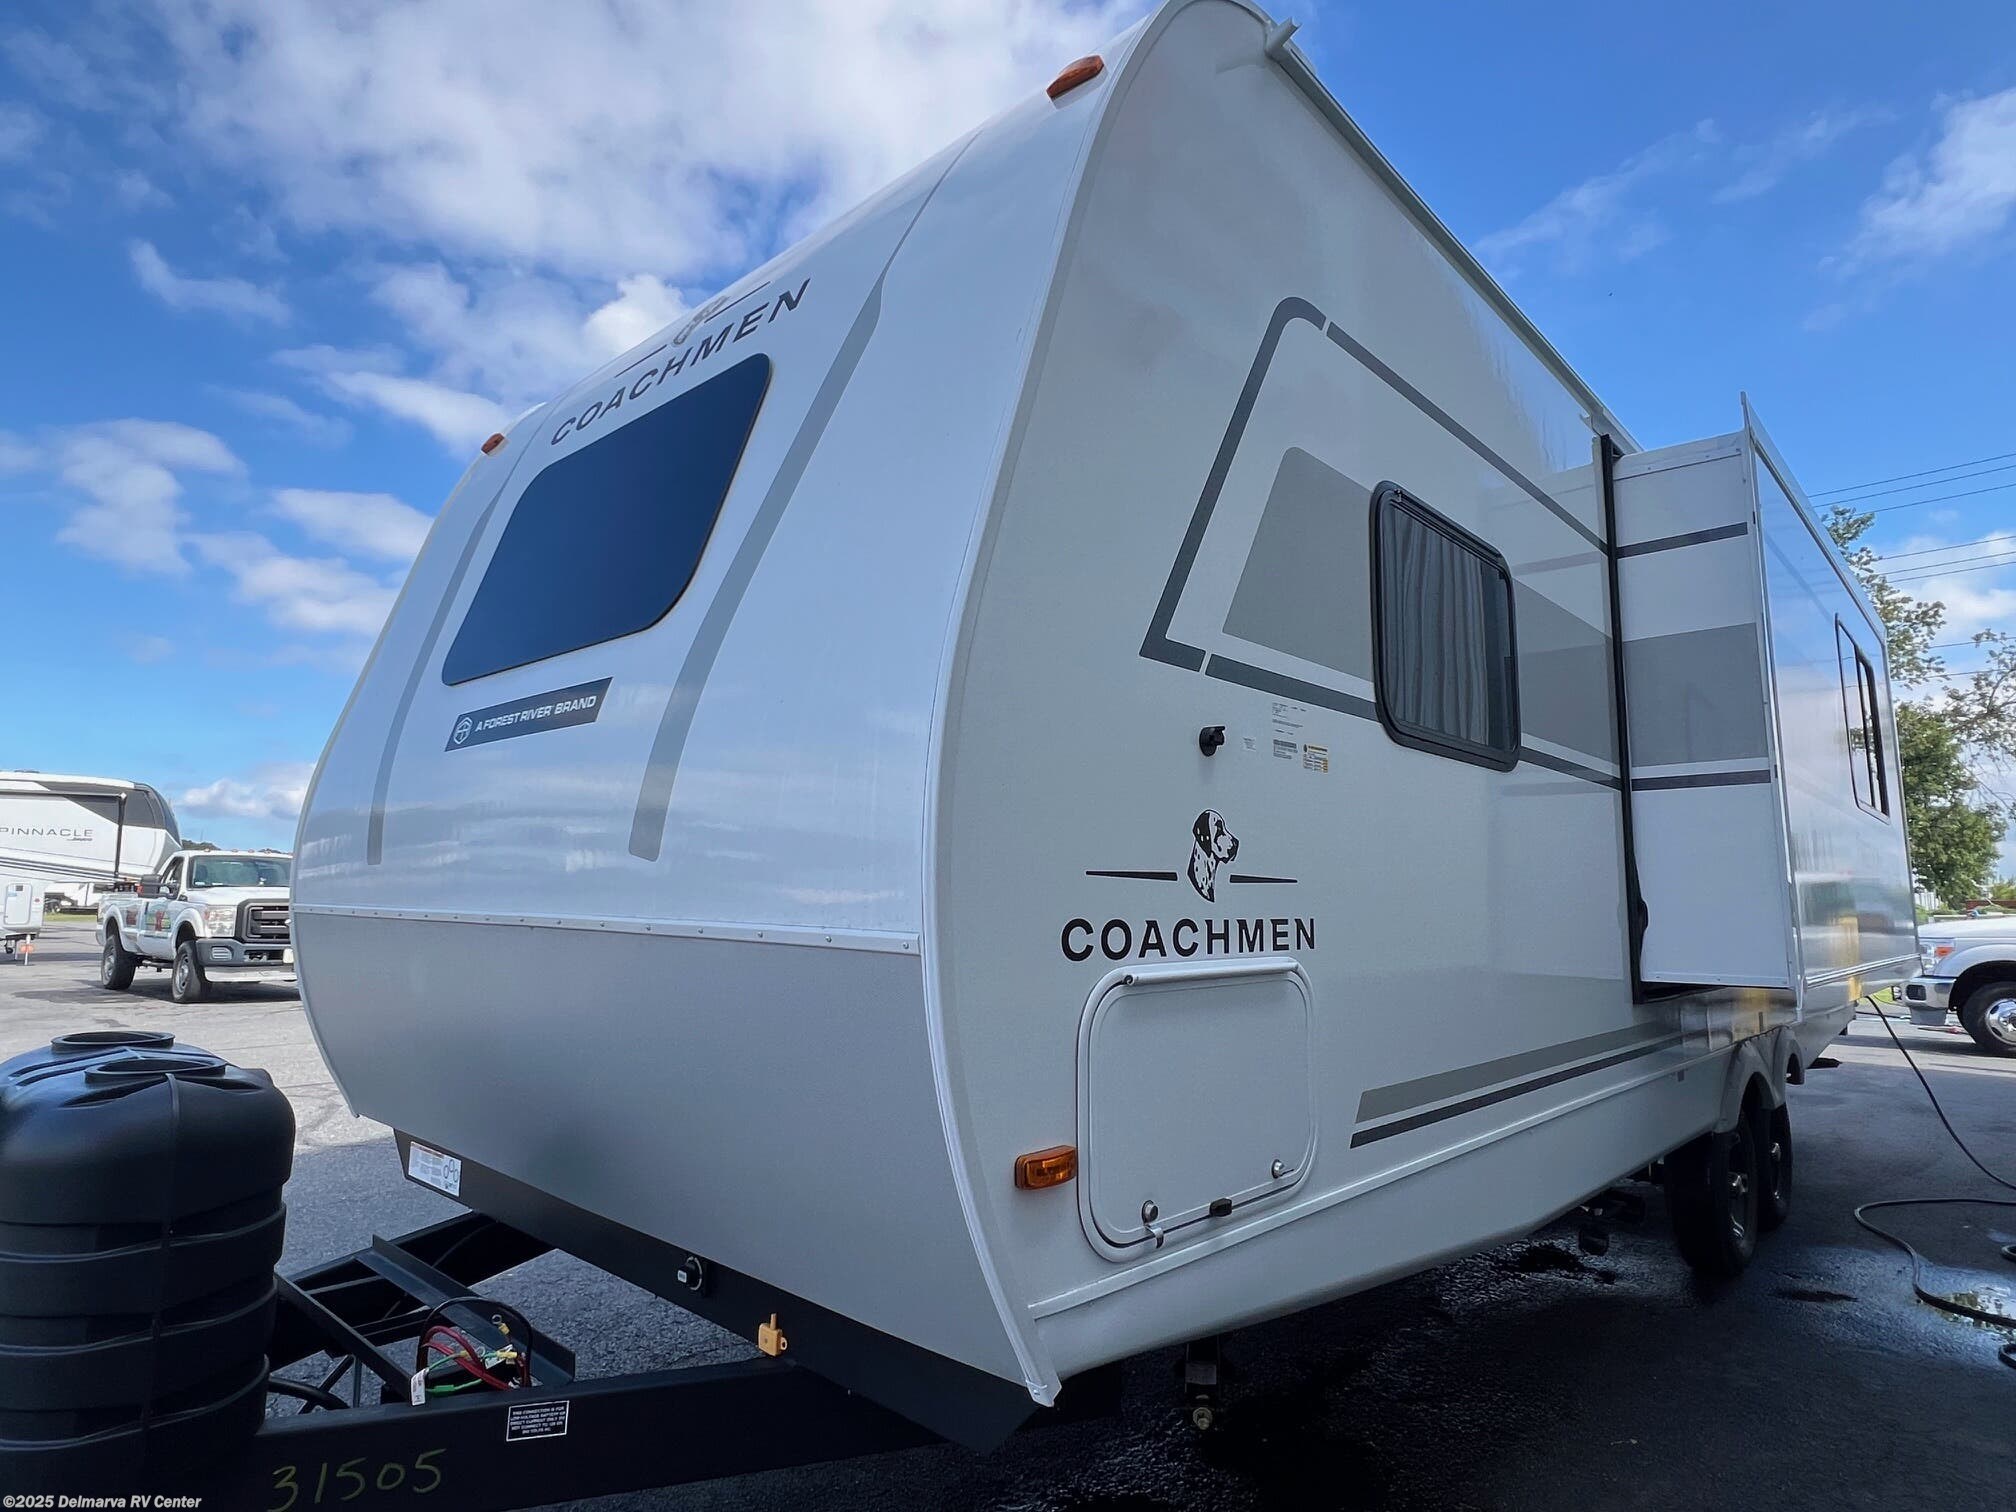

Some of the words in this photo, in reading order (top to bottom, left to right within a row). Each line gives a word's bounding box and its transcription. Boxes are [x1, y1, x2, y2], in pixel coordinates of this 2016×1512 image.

[551, 278, 811, 445] COACHMEN
[474, 721, 482, 732] A
[483, 712, 521, 731] FOREST
[520, 705, 552, 722] RIVER
[554, 695, 597, 715] BRAND
[0, 827, 94, 838] PINNACLE
[1060, 917, 1315, 962] COACHMEN
[267, 1448, 447, 1512] 31505
